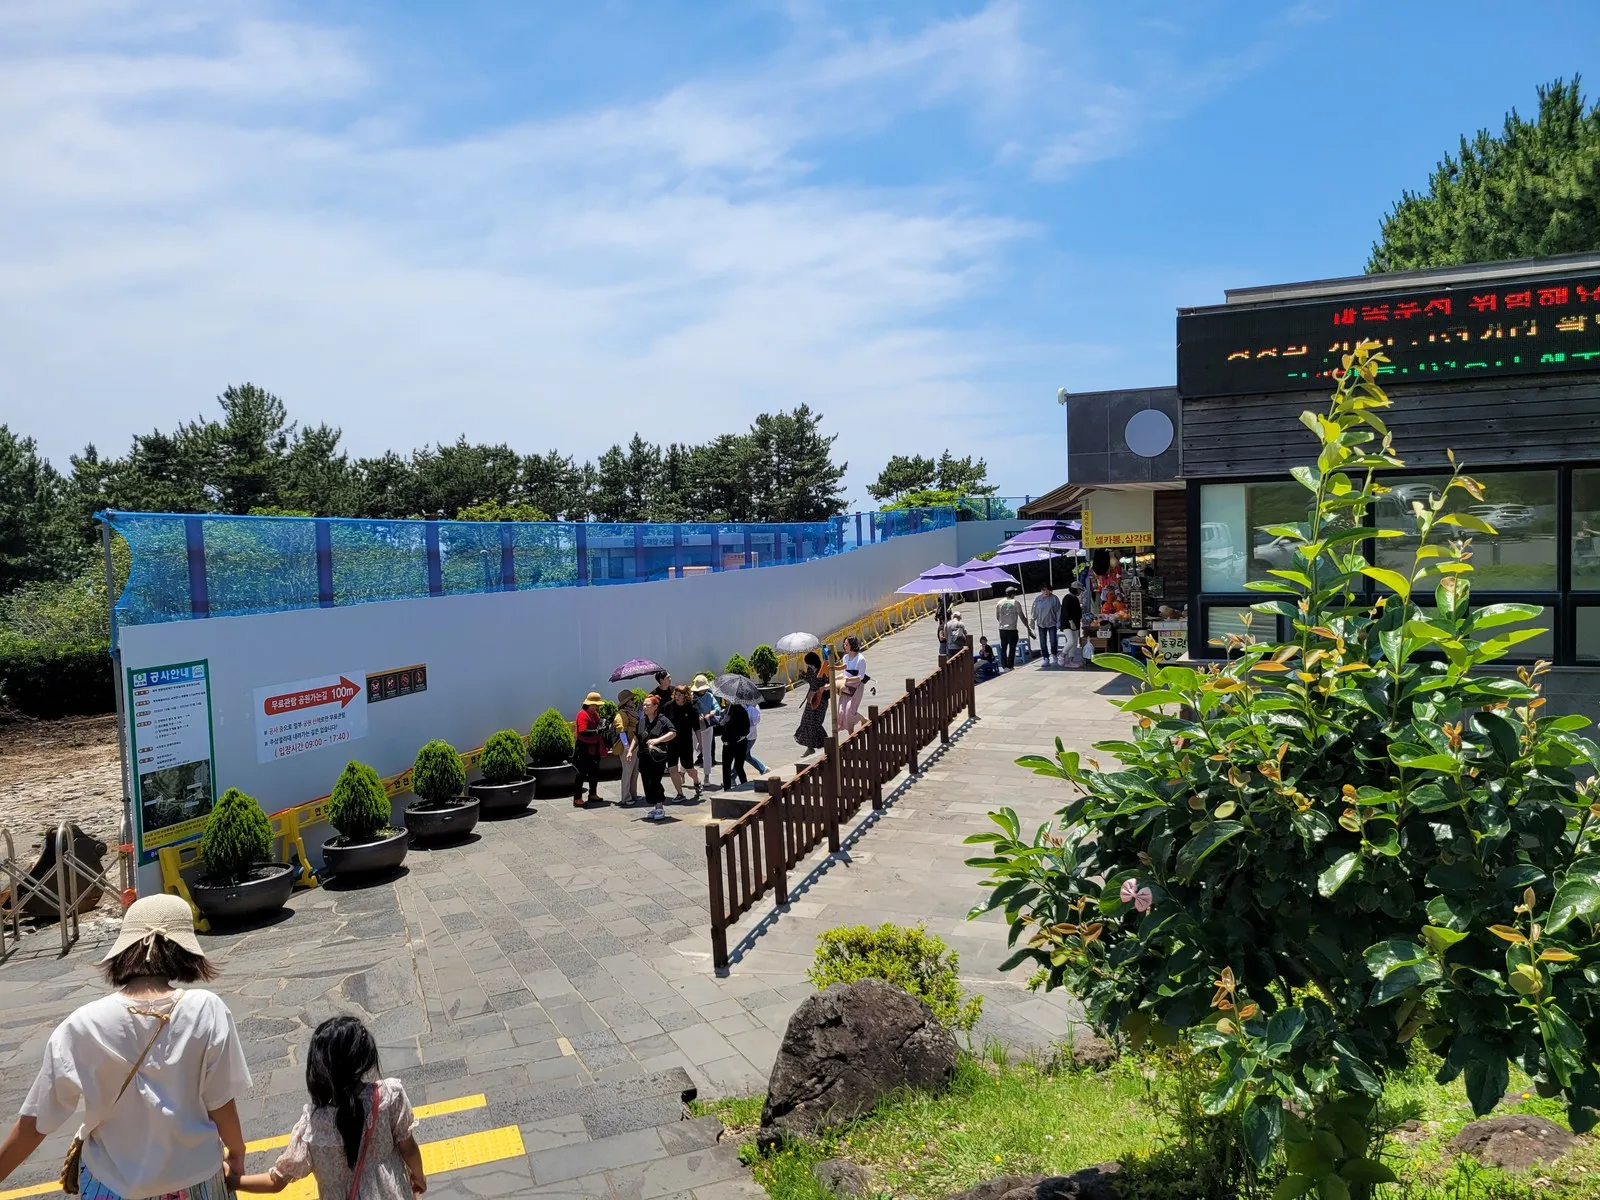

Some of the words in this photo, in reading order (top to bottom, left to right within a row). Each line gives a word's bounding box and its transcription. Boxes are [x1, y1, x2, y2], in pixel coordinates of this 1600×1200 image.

[150, 667, 189, 683] 공사안내
[271, 697, 297, 710] 무료관람
[298, 690, 328, 705] 공원가는길
[331, 686, 354, 699] 100m
[329, 711, 346, 721] 무료관람
[269, 734, 292, 746] 주상절리대
[292, 730, 310, 740] 내려가는
[310, 727, 319, 735] 길은
[278, 742, 304, 756] 입장시간
[304, 738, 323, 750] 09:00
[329, 732, 346, 743] 17:40
